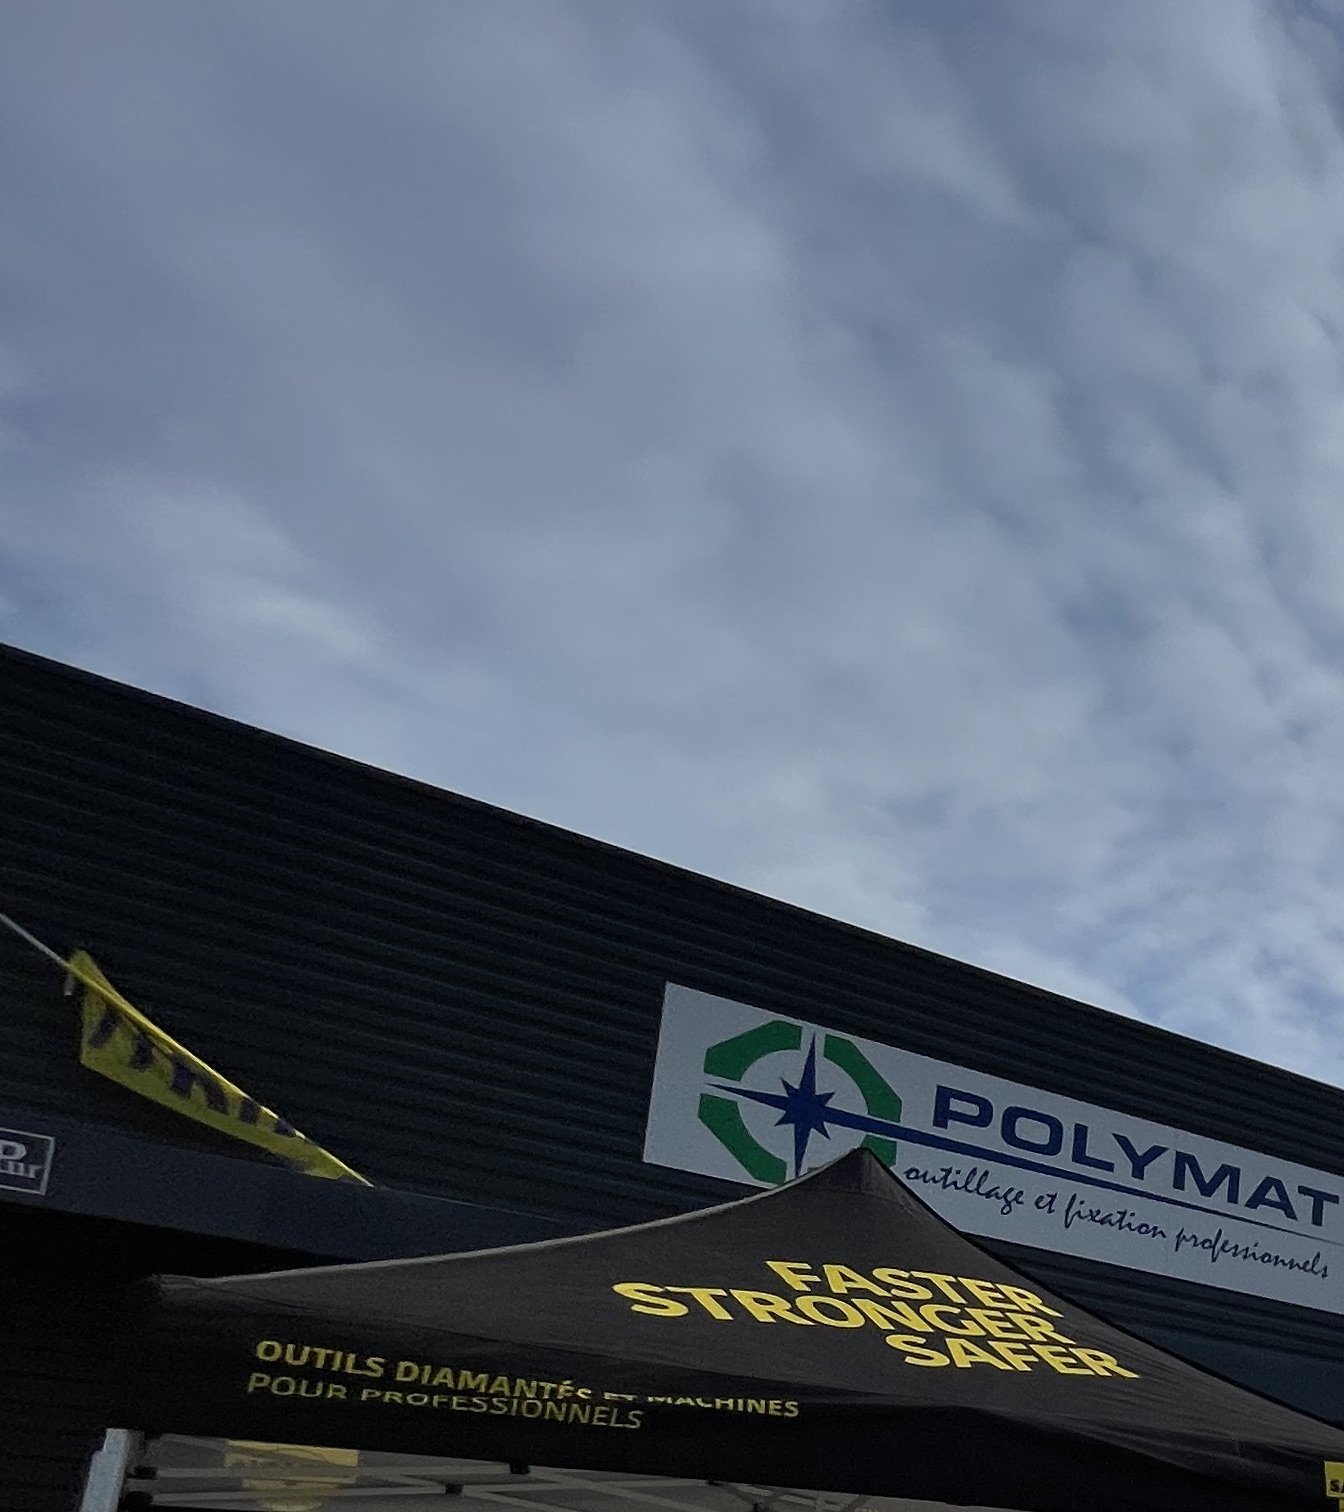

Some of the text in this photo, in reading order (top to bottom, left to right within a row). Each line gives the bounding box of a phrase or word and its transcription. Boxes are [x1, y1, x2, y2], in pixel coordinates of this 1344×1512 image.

[932, 1084, 1340, 1228] POLYMAT
[903, 1163, 1330, 1280] outillage et fixation professionnels
[611, 1281, 1078, 1346] STRONGER
[765, 1259, 1065, 1319] FASTER
[255, 1340, 386, 1378] OUTILS
[885, 1333, 1140, 1380] SAFER
[246, 1371, 645, 1430] POUR PROFESSIONNELS
